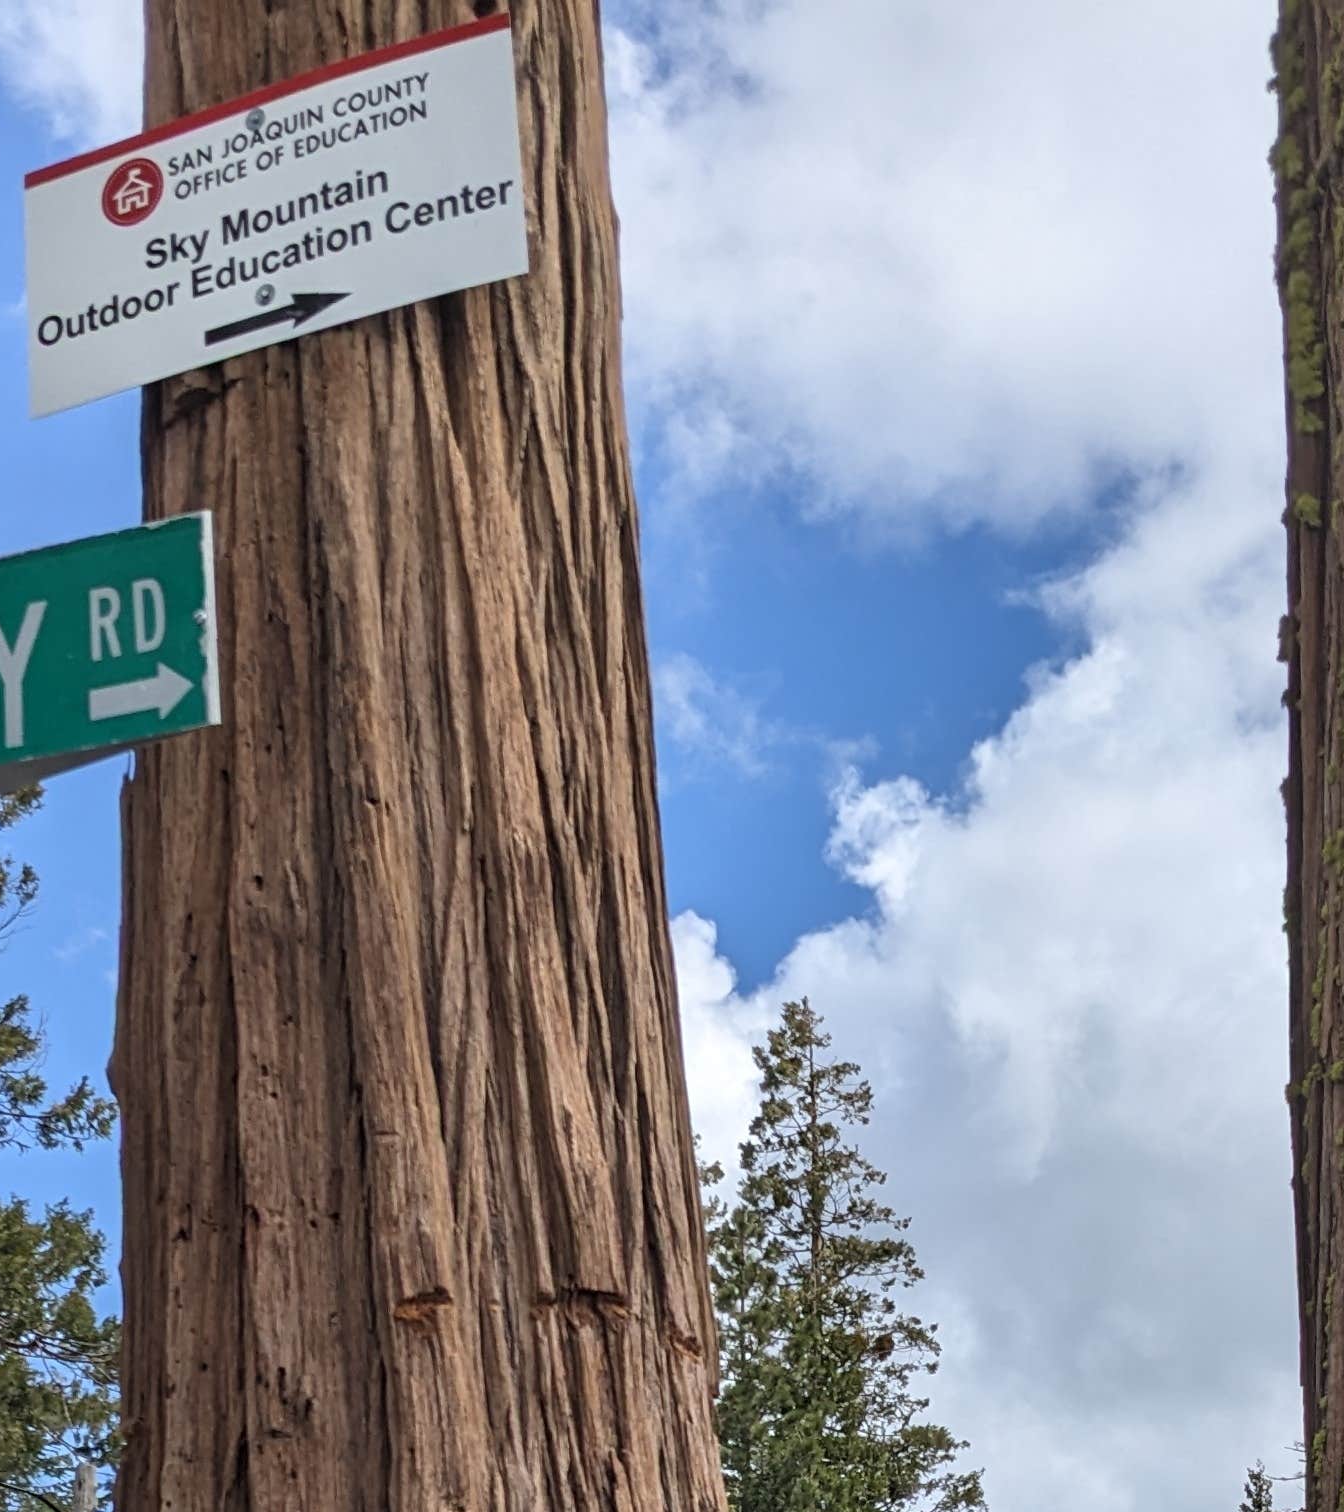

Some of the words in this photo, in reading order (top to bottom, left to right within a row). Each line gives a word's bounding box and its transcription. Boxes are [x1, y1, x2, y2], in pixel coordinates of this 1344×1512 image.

[168, 146, 213, 176] SAN
[222, 106, 323, 159] JOAQUIN
[333, 72, 430, 117] COUNTY
[174, 160, 247, 200] OFFICE
[255, 147, 285, 172] OF
[294, 101, 427, 158] EDUCATION
[37, 280, 180, 347] Outdoor
[191, 220, 373, 298] Education
[385, 179, 513, 233] Center
[144, 228, 208, 269] Sky
[221, 170, 389, 246] Mountain
[88, 578, 167, 663] RD
